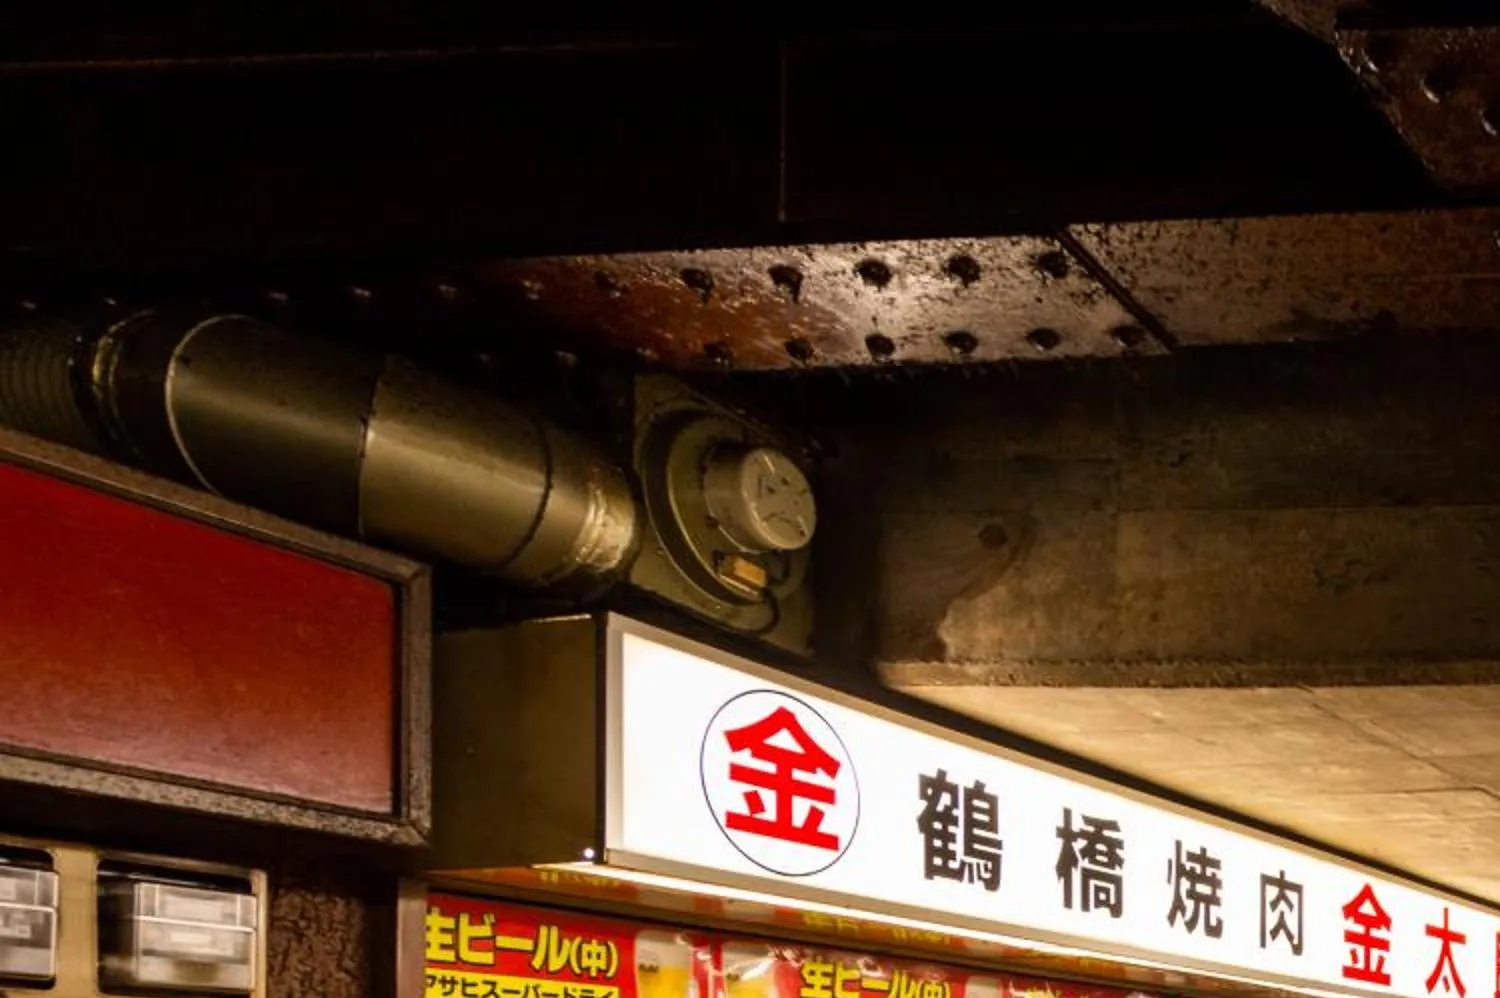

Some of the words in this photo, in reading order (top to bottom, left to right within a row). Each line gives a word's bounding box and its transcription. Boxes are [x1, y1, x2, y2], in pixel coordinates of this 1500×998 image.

[723, 705, 841, 852] 金
[917, 768, 1303, 957] 鶴橋焼肉
